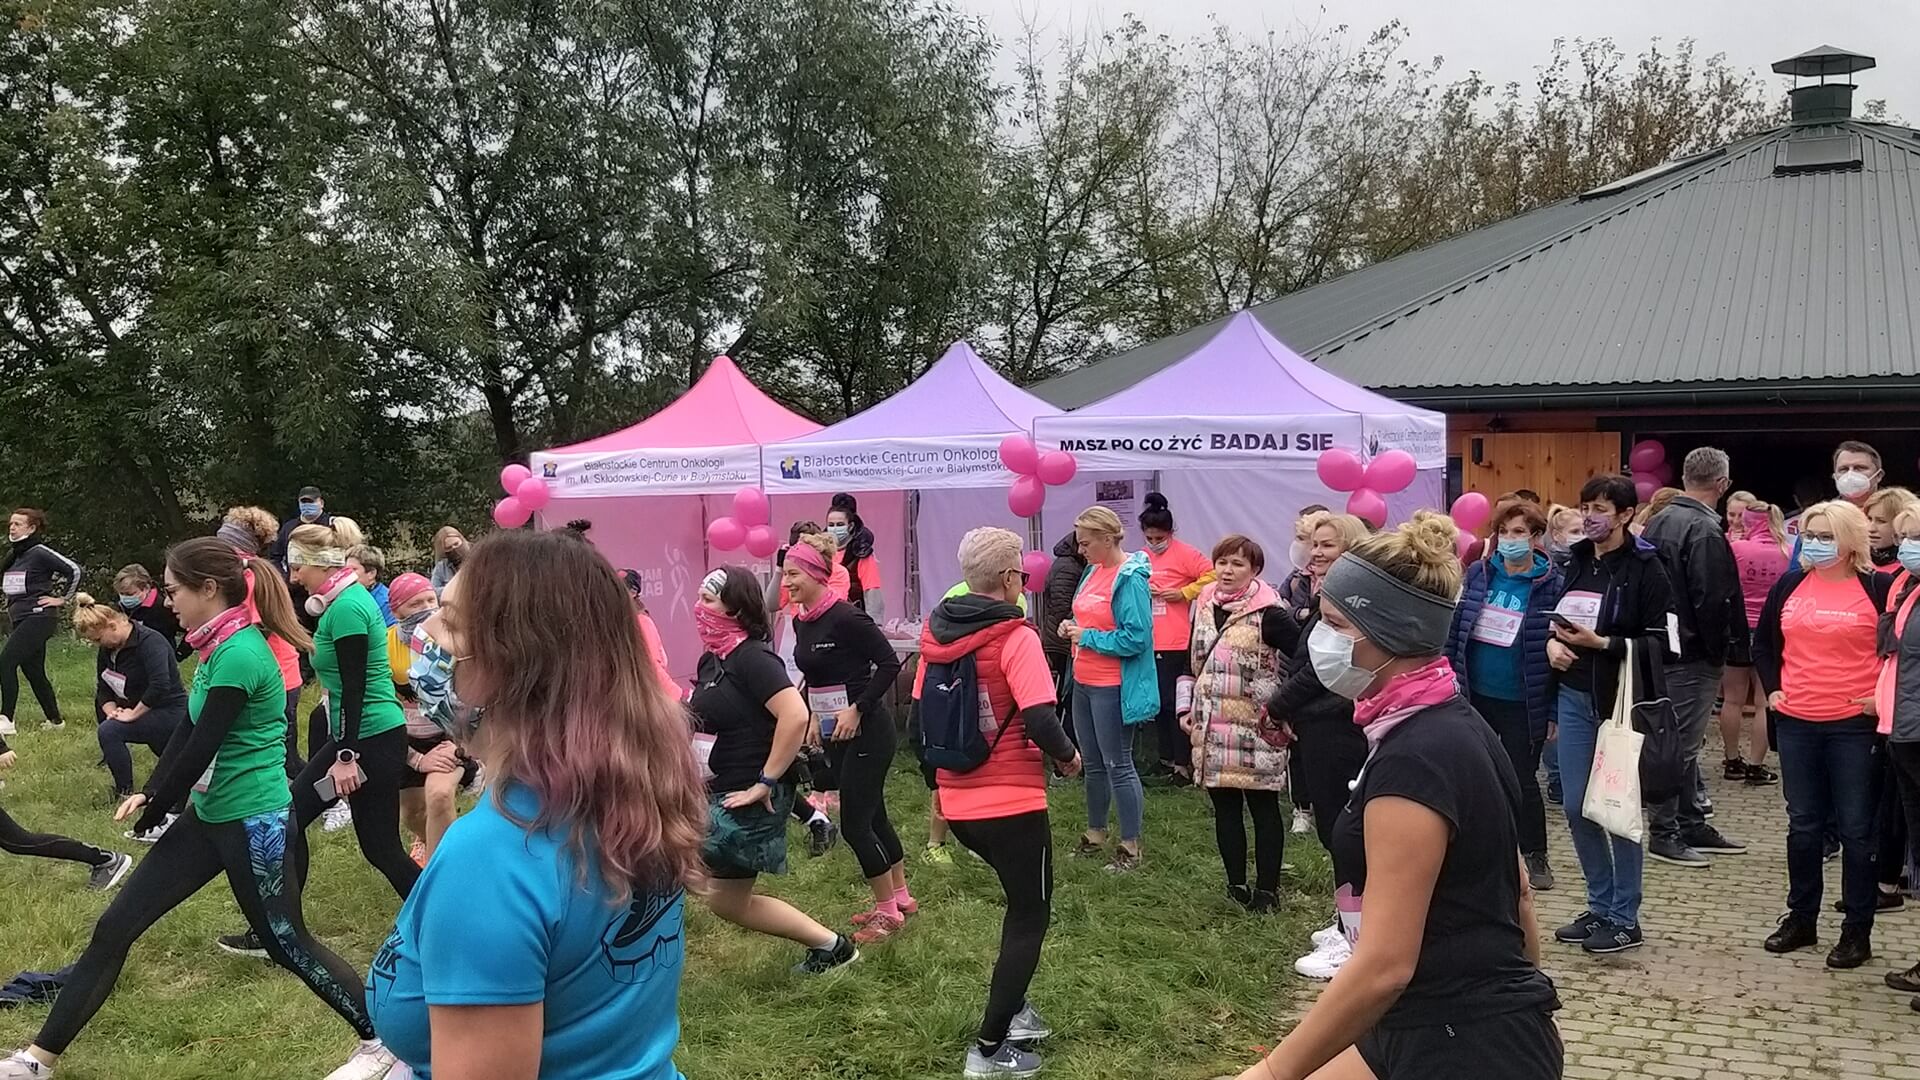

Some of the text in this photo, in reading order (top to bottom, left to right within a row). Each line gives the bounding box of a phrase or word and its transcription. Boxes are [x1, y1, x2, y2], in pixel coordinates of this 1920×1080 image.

[1060, 439, 1106, 451] MASZ
[1111, 439, 1134, 450] PO
[1139, 438, 1164, 451] CO
[1168, 435, 1203, 450] ŻYĆ
[1210, 433, 1289, 450] BADAJ
[584, 455, 724, 471] Białostockie Centrum Onkologii
[803, 447, 998, 468] Białostockie Centrum Onkolog
[681, 473, 687, 481] w
[818, 468, 841, 478] Marii
[843, 464, 932, 477] Skłodowskiej-Curie
[1345, 594, 1371, 608] 4F
[1587, 601, 1597, 614] 3
[1506, 619, 1516, 630] 4
[833, 696, 847, 705] 107
